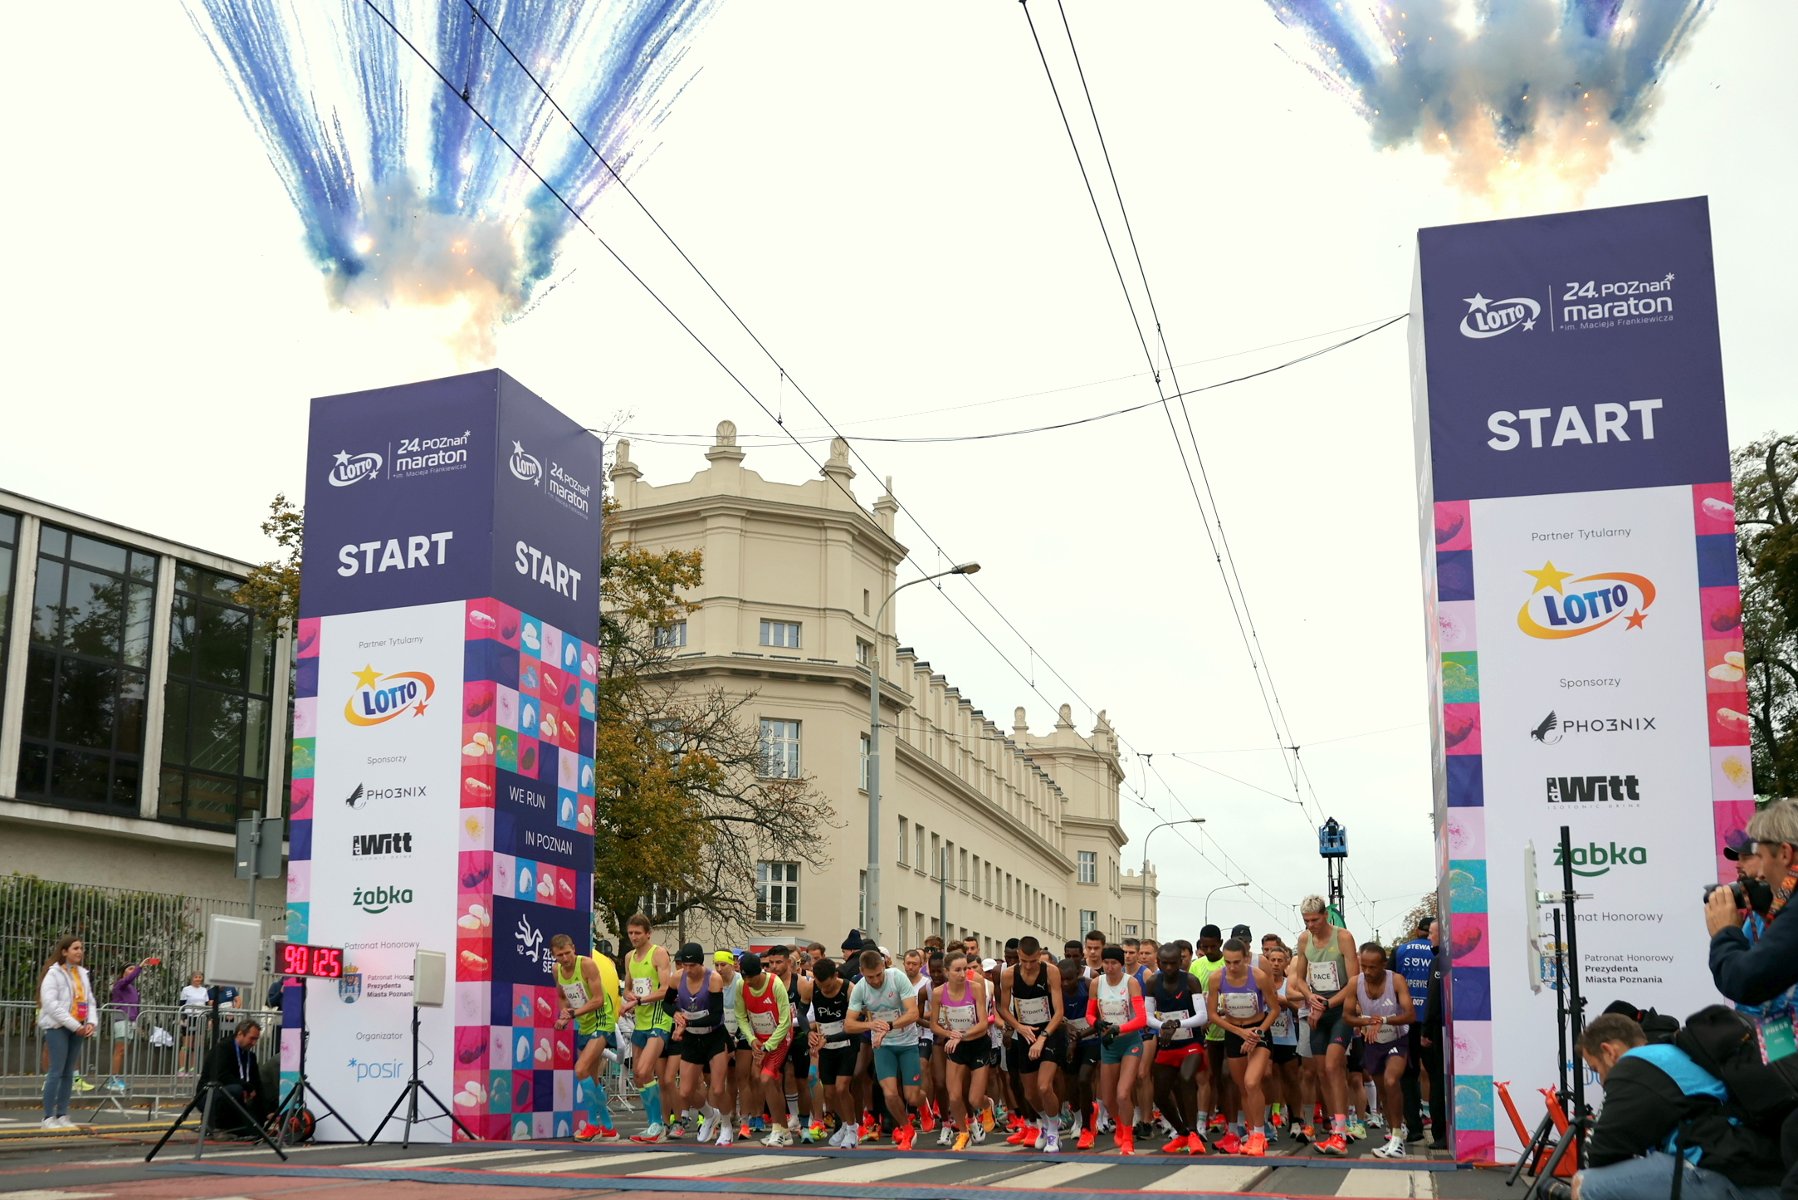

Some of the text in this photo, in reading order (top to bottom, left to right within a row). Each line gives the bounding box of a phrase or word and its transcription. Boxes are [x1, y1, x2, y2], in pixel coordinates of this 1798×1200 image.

[1563, 281, 1599, 301] 24.
[1475, 304, 1525, 331] LOTTO
[1563, 297, 1673, 322] maraton
[1580, 320, 1614, 330] Macieja
[1617, 315, 1674, 326] Frankiewicza
[1487, 398, 1663, 451] START
[397, 438, 421, 455] 24.
[339, 458, 372, 480] LOTTO
[396, 449, 467, 472] maraton
[429, 463, 467, 475] Frankiewicza
[516, 455, 537, 475] LOTTO
[549, 479, 589, 513] maraton
[1531, 527, 1632, 542] Partner Tytularny
[337, 531, 453, 577] START
[515, 540, 581, 601] START
[1544, 584, 1628, 626] LOTTO
[358, 635, 424, 649] Partner Tytularny
[1559, 677, 1622, 690] Sponsorzy
[362, 681, 417, 716] LOTTO
[367, 755, 407, 766] Sponsorzy
[509, 785, 546, 810] WE RUN
[1558, 775, 1640, 802] Witt
[360, 832, 412, 855] Witt
[525, 830, 573, 856] IN POZNAN
[352, 885, 413, 906] żabka
[1545, 912, 1664, 924] Ptnat Honorowy
[344, 939, 420, 951] Patronat Honorowy
[1406, 943, 1433, 951] STEWA
[1585, 954, 1674, 964] Patronat Honorowy
[1585, 965, 1639, 974] Prezydenta
[367, 983, 401, 991] Prezydenta
[388, 990, 413, 998] Poznani
[817, 1006, 842, 1018] Plus
[356, 1032, 403, 1042] Organizator
[357, 1058, 404, 1082] posir
